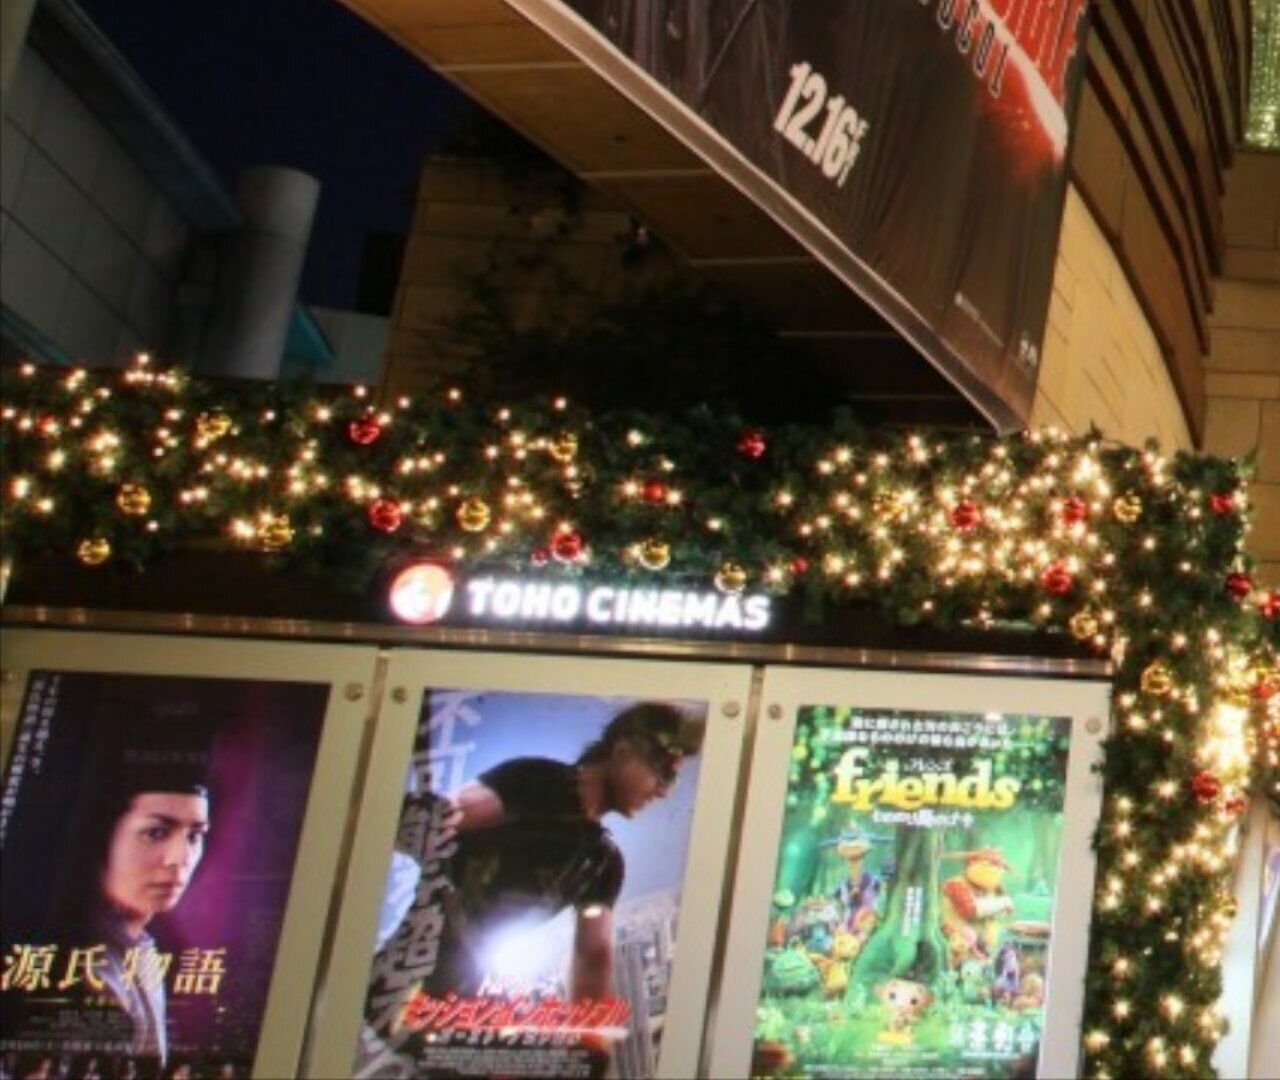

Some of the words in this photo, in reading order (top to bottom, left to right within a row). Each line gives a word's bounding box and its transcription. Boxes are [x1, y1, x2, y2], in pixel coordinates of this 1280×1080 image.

[468, 578, 581, 619] TOHO
[587, 586, 771, 630] CINEMAS
[831, 746, 1022, 811] friends
[1, 943, 227, 995] 源氏物語
